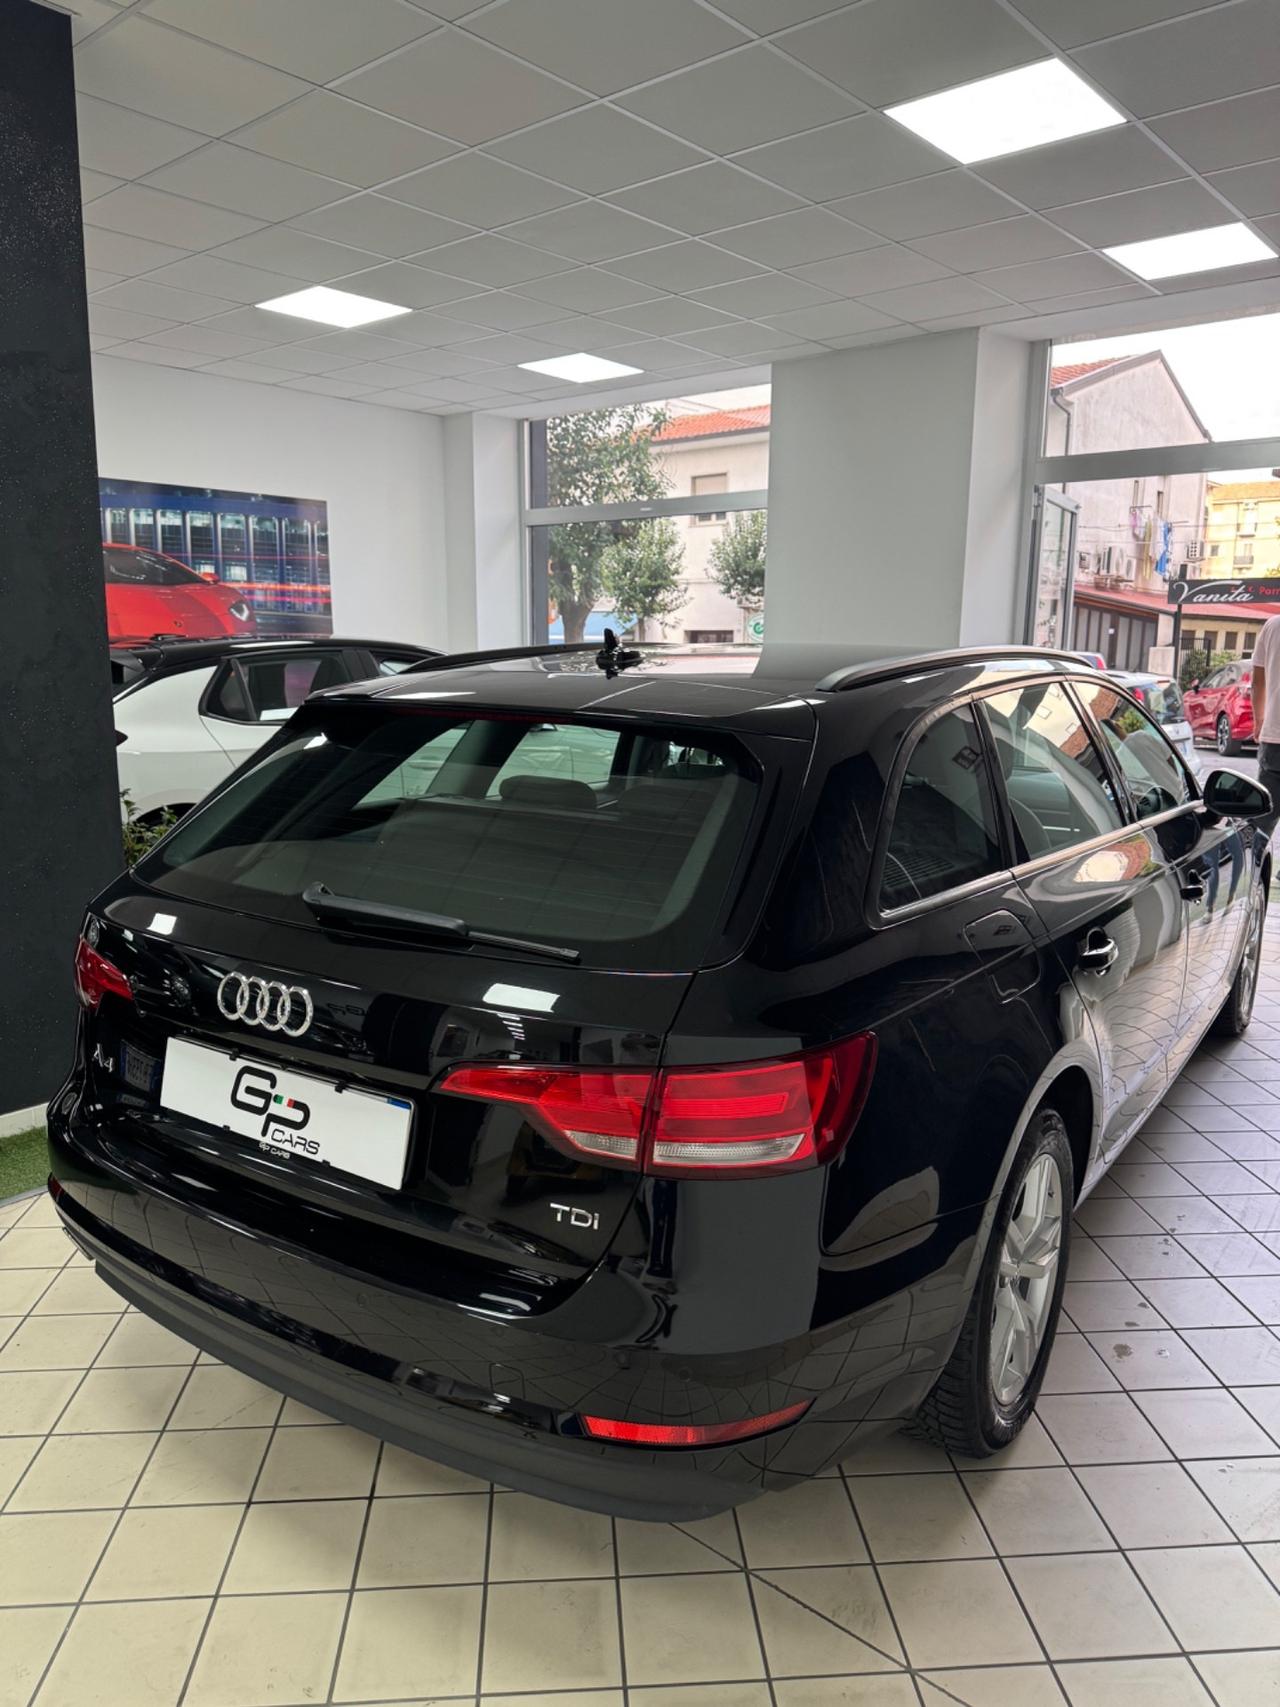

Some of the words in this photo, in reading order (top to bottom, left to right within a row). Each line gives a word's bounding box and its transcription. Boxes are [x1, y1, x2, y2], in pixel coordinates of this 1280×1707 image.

[93, 1043, 113, 1073] A4
[231, 1065, 311, 1137] GP
[271, 1128, 321, 1155] CARS
[550, 1202, 600, 1230] TDI
